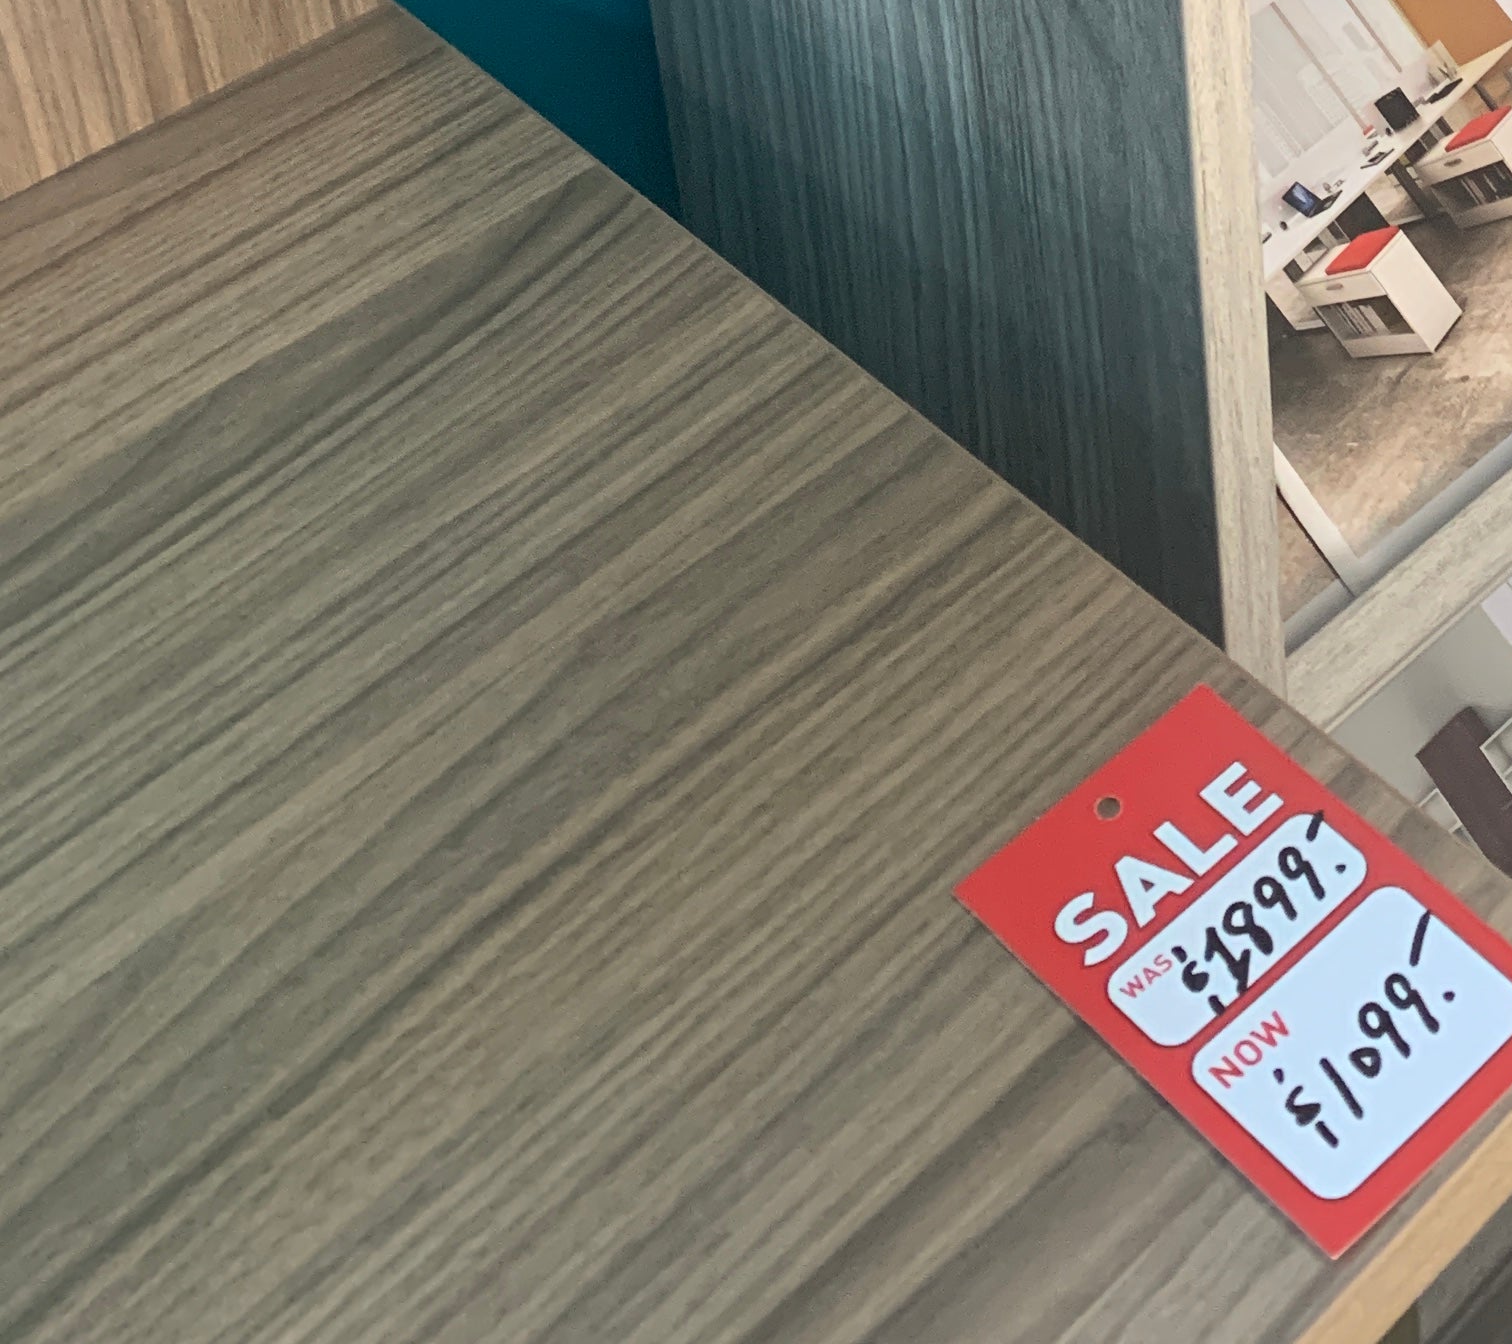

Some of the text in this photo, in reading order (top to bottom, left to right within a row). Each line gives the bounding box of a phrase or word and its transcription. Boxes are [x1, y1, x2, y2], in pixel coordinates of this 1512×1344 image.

[1053, 761, 1283, 967] SALE
[1118, 953, 1175, 1000] WAS
[1208, 1010, 1291, 1090] NOW
